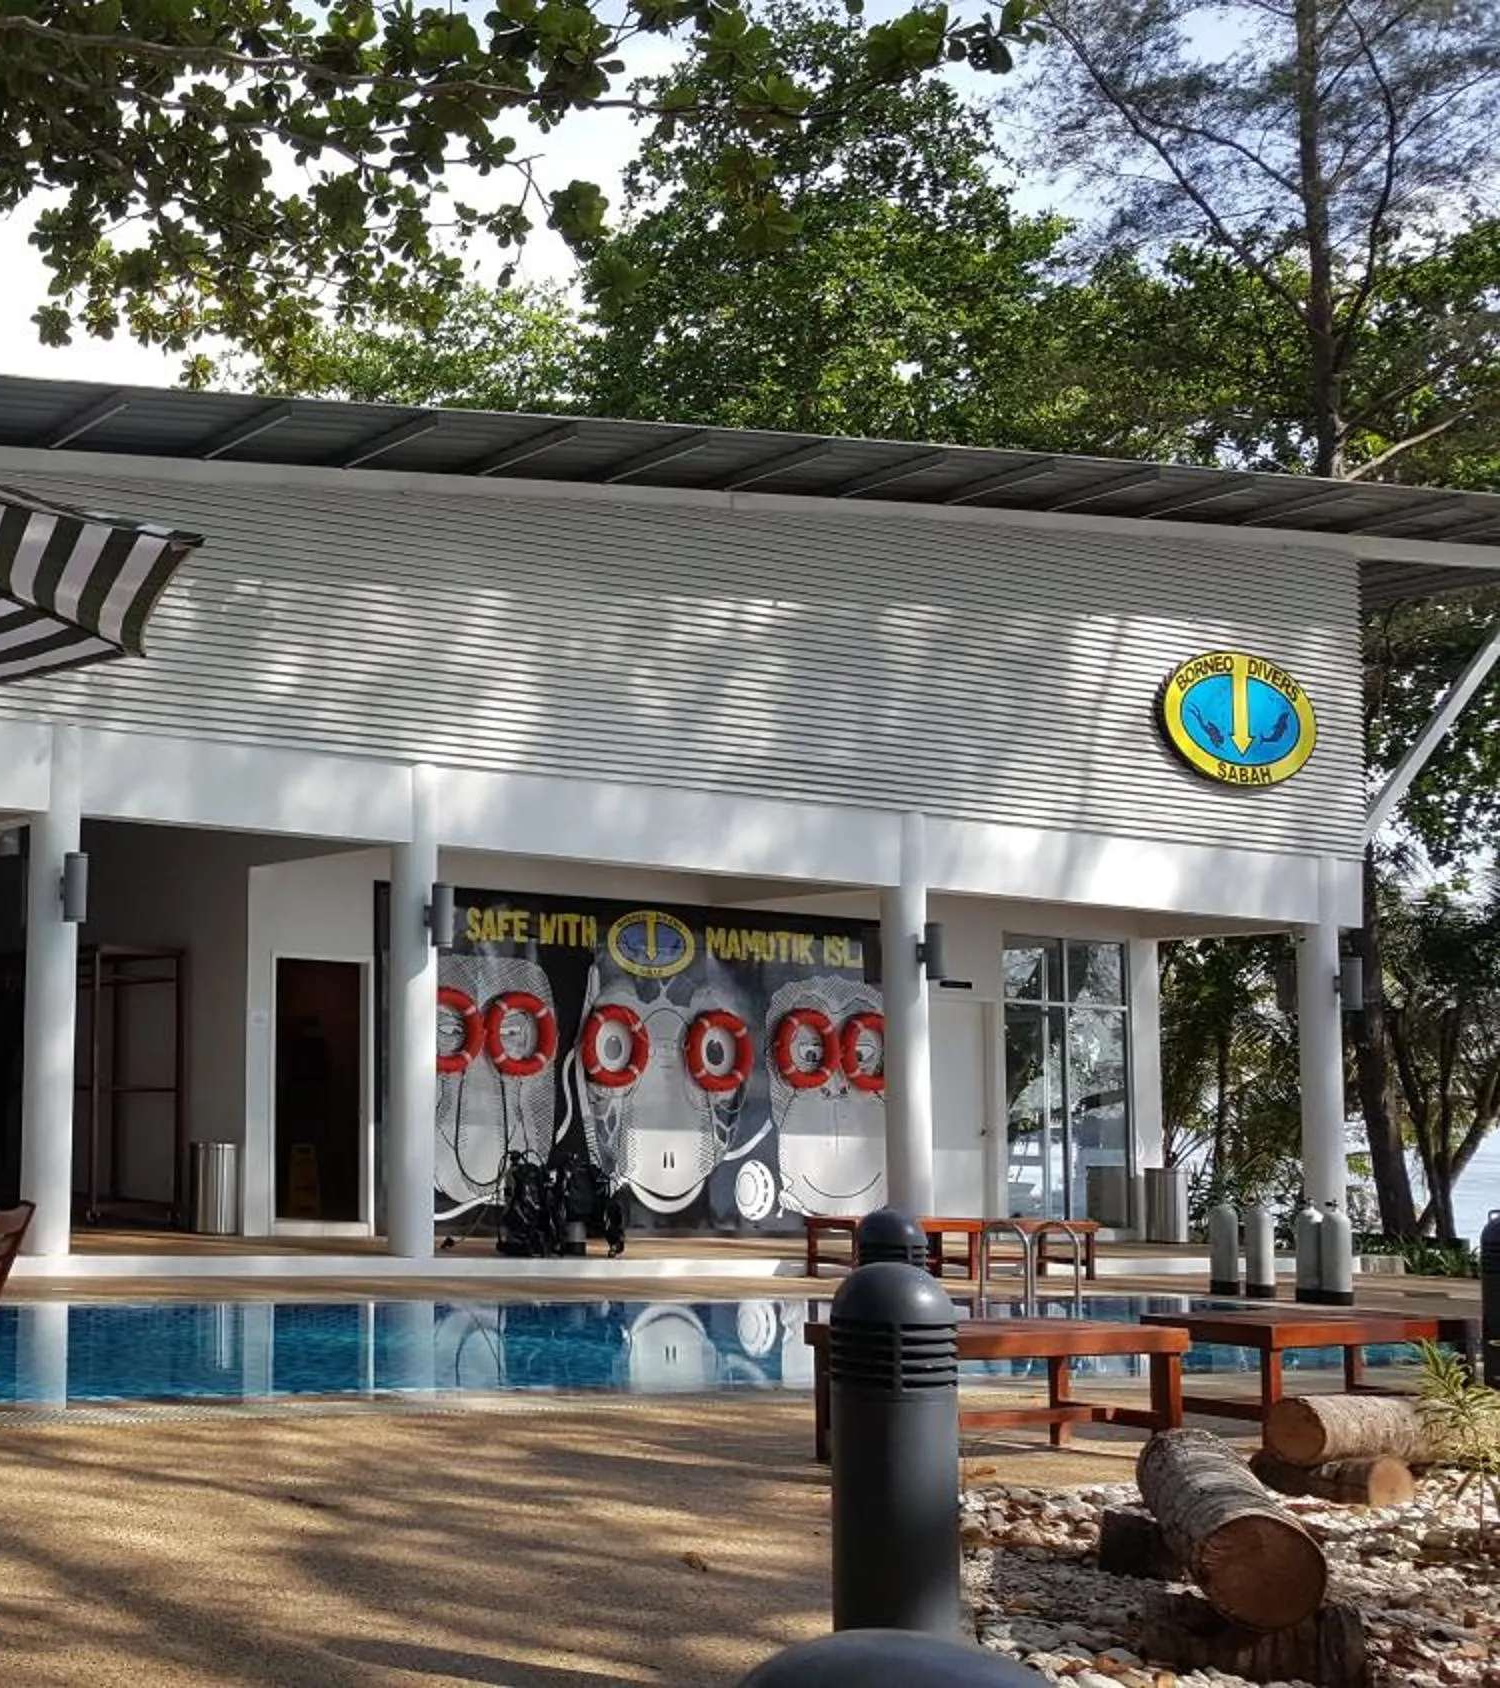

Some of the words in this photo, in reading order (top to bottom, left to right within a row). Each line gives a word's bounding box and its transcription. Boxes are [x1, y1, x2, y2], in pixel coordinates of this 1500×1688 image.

[1175, 655, 1234, 691] BORNEO
[1247, 659, 1299, 701] DIVERS
[1217, 763, 1272, 783] SABAH
[465, 906, 530, 943] SAFE
[539, 912, 597, 947] WITH
[705, 926, 815, 965] MAMUTIK
[823, 935, 863, 969] ISL
